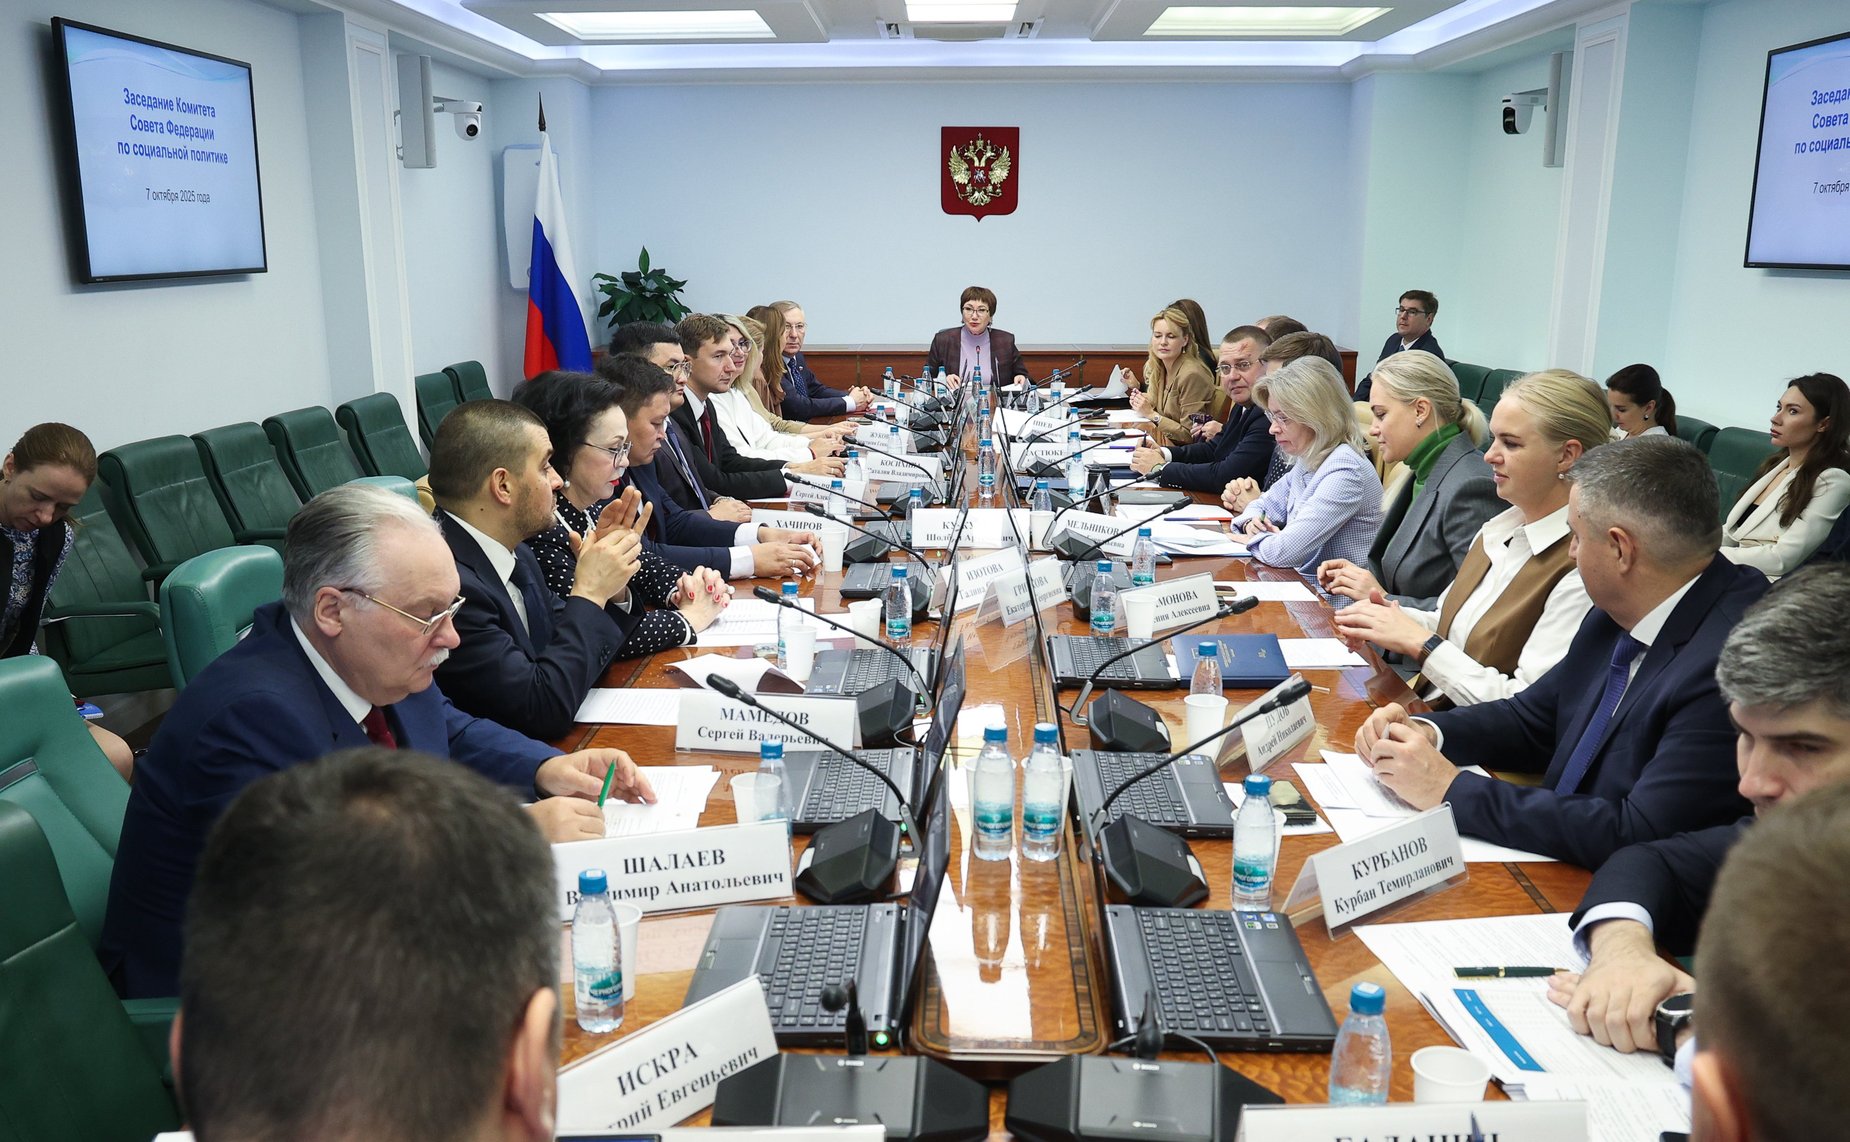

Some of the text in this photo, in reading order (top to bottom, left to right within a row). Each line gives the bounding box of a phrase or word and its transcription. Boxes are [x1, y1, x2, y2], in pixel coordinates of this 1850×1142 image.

[123, 87, 216, 118] Заседание Комитета
[130, 114, 214, 142] Совета Федерации
[1812, 111, 1849, 129] Совета
[117, 141, 228, 165] по социальной политике
[1794, 140, 1807, 155] по
[145, 188, 210, 204] 7 октября 2025 года
[1813, 180, 1850, 196] 7 октября
[775, 520, 822, 531] ХАЧИРОВ
[966, 563, 1004, 581] ИЗОТОВА
[1156, 590, 1198, 608] МОНОВА
[1171, 604, 1211, 619] Алексеевна
[720, 707, 809, 726] МАМЕДОВ
[697, 725, 744, 742] Сергей
[1257, 736, 1278, 757] Андрей
[623, 848, 726, 875] ШАЛАЕВ
[1351, 836, 1428, 880] КУРБАНОВ
[566, 872, 784, 906] Вимир Анатольевич
[1333, 855, 1455, 914] Курбан Темирланович
[616, 1041, 699, 1097] ИСКРА
[656, 1046, 759, 1111] Евгеньевич
